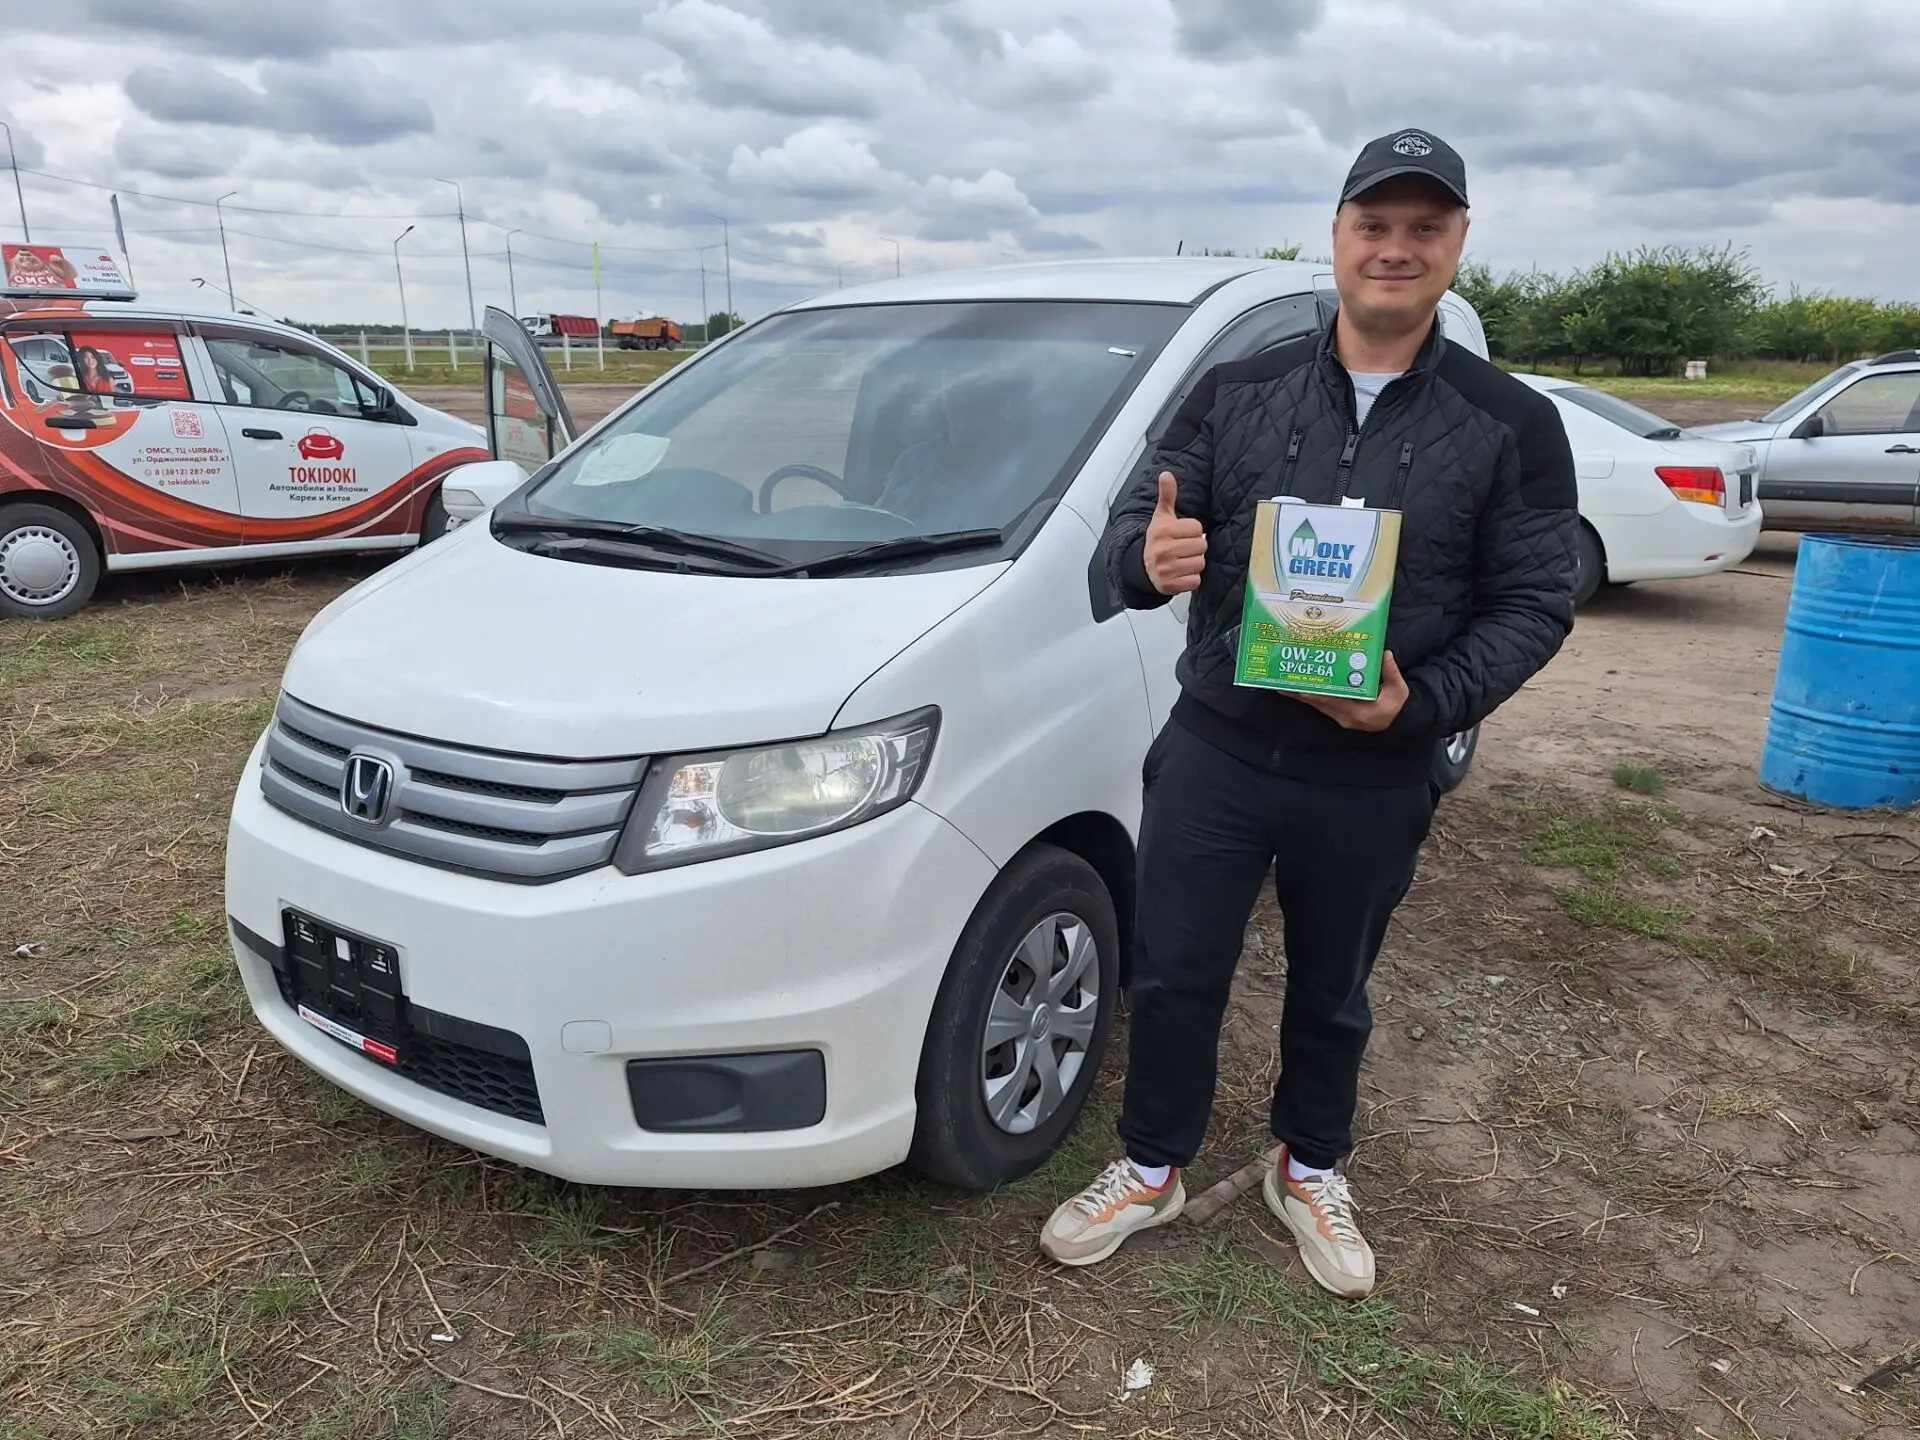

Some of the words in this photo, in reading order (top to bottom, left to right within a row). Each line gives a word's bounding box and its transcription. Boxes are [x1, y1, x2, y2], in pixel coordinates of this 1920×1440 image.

[288, 466, 356, 484] TOKIDOKI
[269, 483, 325, 492] Автомобили
[338, 485, 369, 493] Японии
[289, 493, 317, 503] Кореи
[326, 494, 351, 502] Китая
[1290, 537, 1355, 560] MOLY
[1289, 558, 1353, 579] GREEN
[1281, 646, 1337, 665] 0W-20
[1279, 661, 1334, 677] SP/GF-6A
